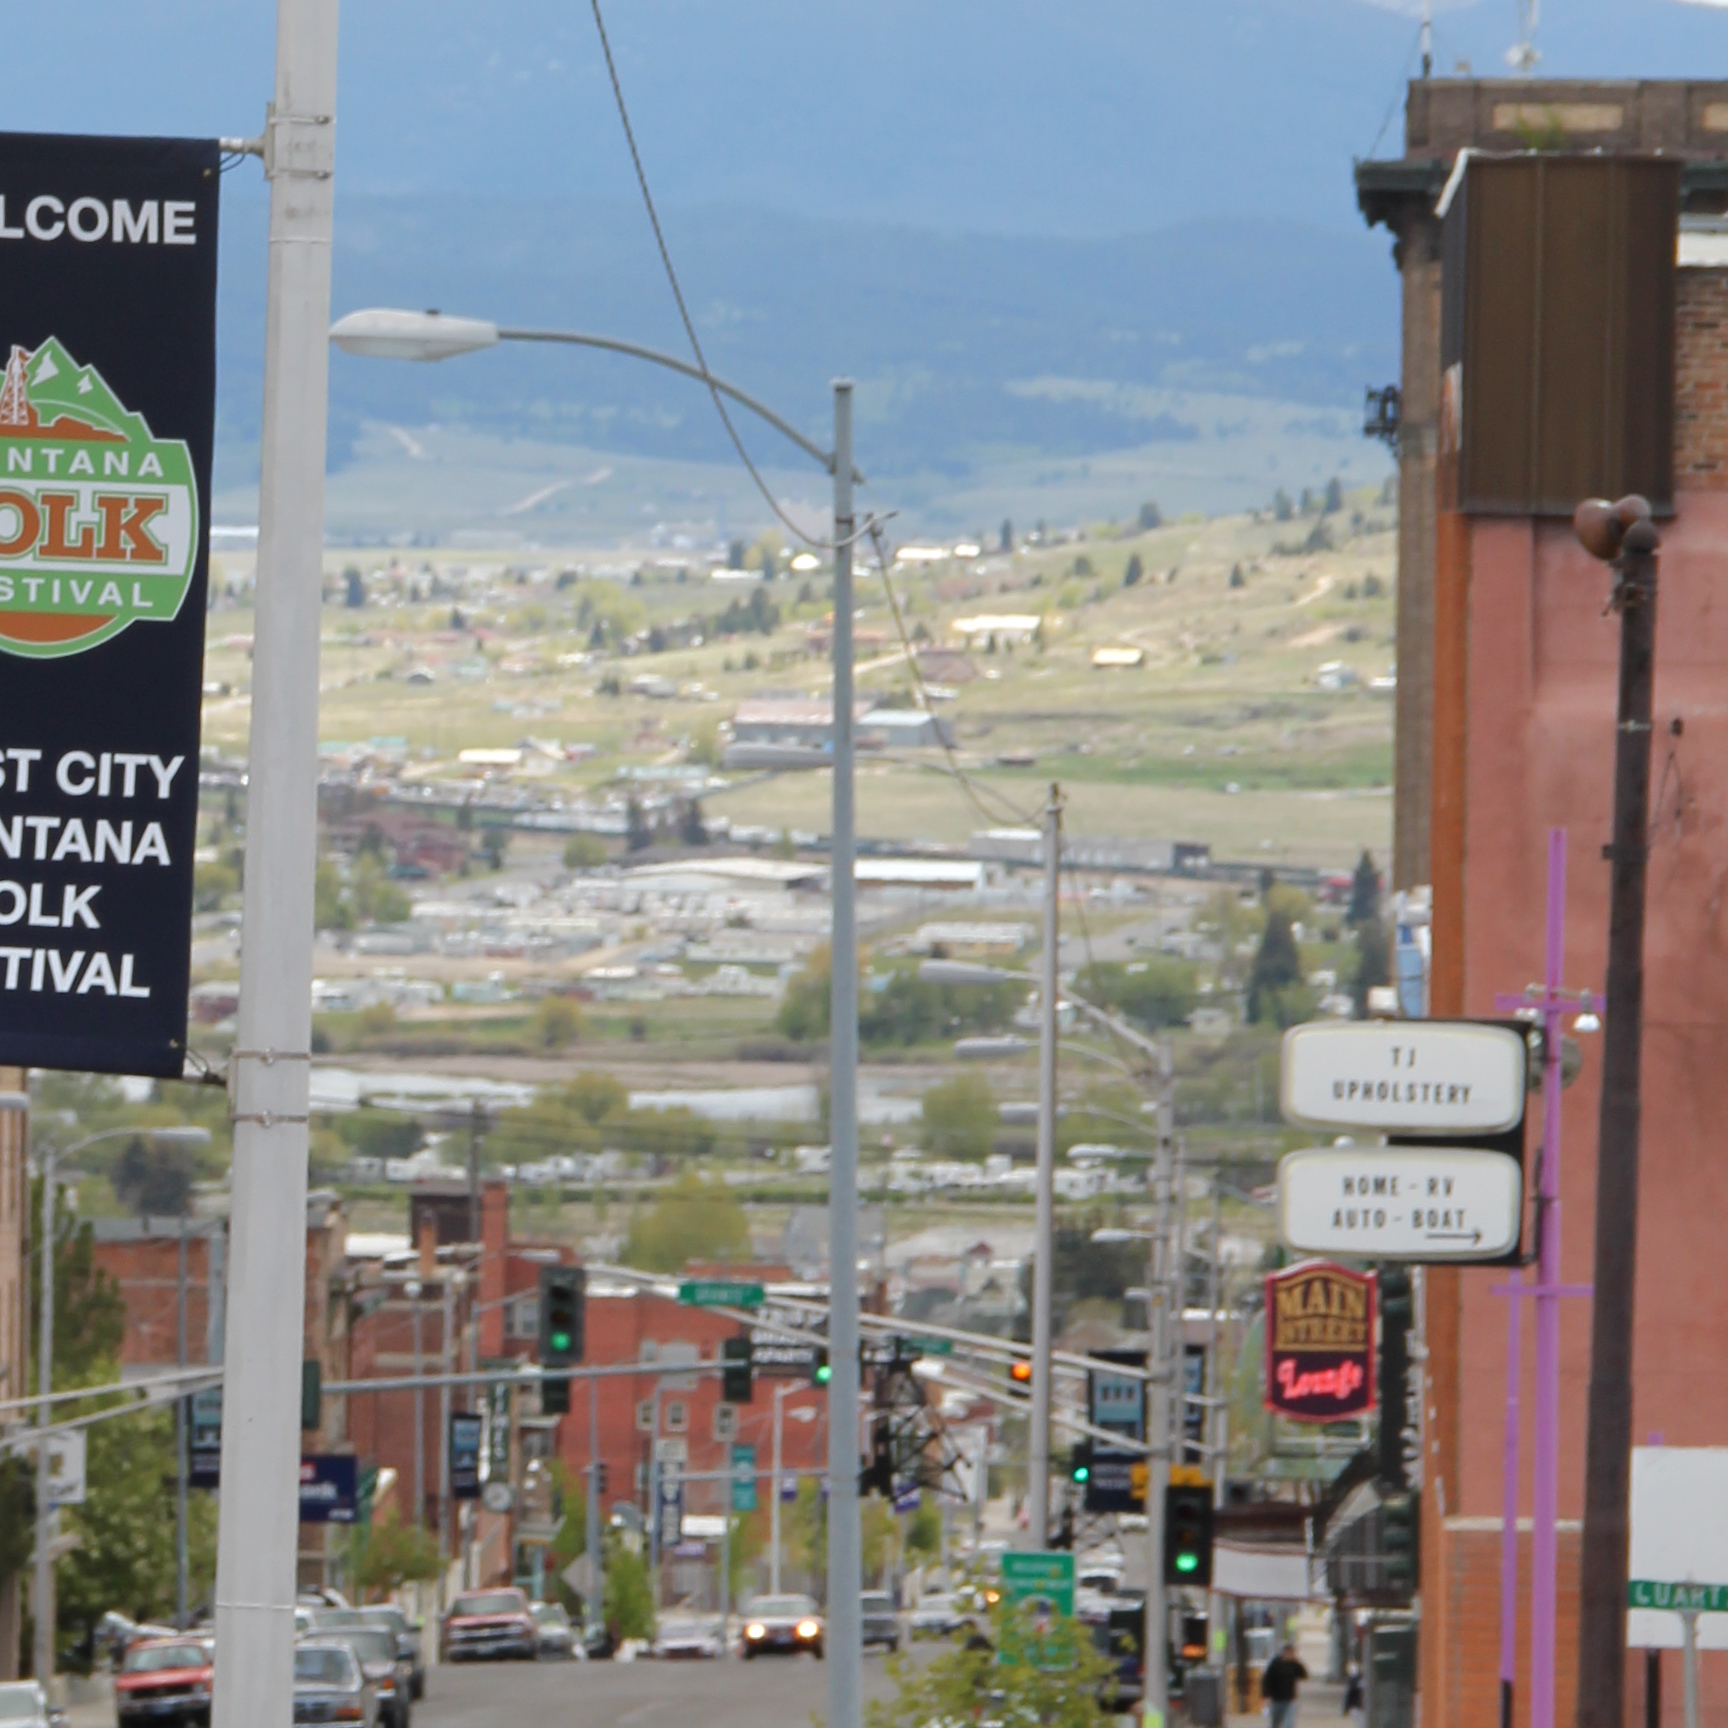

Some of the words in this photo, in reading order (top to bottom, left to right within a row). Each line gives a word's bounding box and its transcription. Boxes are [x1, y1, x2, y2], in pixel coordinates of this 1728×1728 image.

[56, 750, 185, 799] CITY
[1332, 1079, 1471, 1105] UPHOLSTERY
[1342, 1175, 1399, 1198] HOME
[1427, 1175, 1454, 1198] RV
[1331, 1207, 1387, 1231] AUTO
[1410, 1207, 1466, 1230] BOAT
[1276, 1278, 1367, 1318] MAIN
